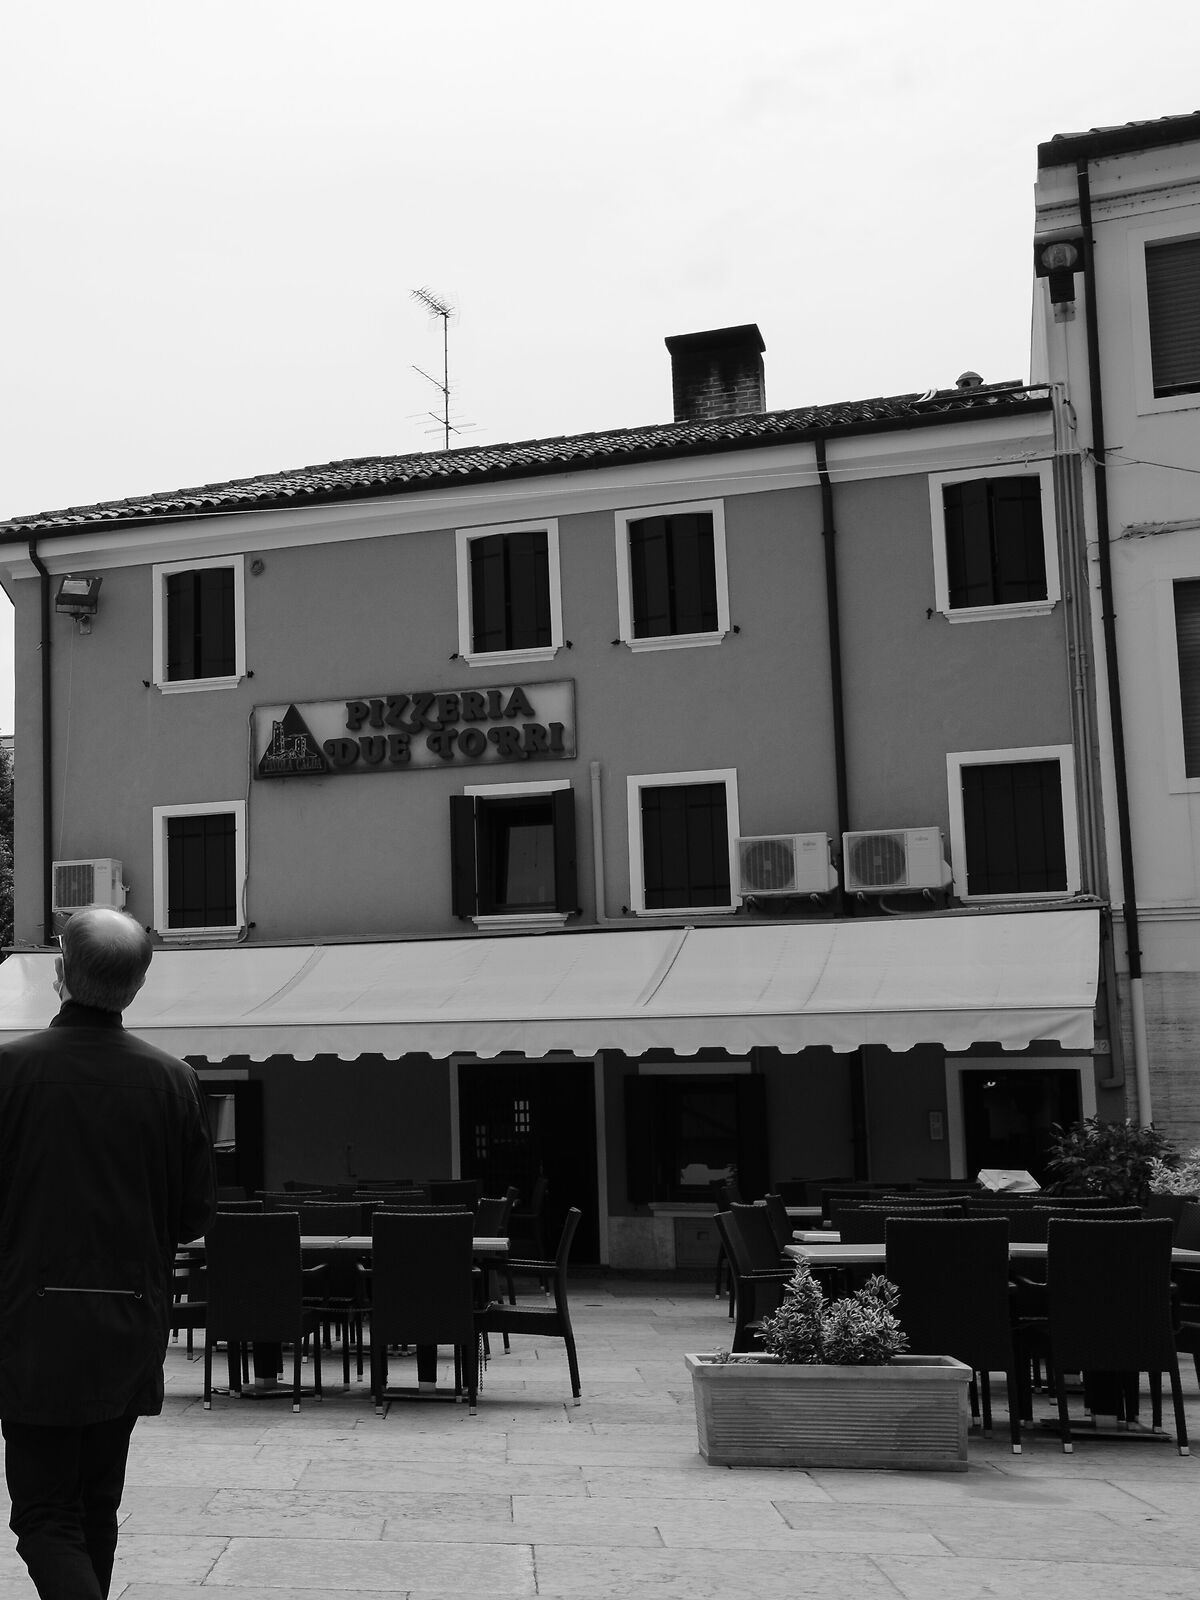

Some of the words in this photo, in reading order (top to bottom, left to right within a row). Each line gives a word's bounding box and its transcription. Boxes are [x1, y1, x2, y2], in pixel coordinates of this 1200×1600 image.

[346, 686, 536, 734] PIZZERIA
[322, 733, 411, 766] DUE
[426, 721, 566, 759] TORRI
